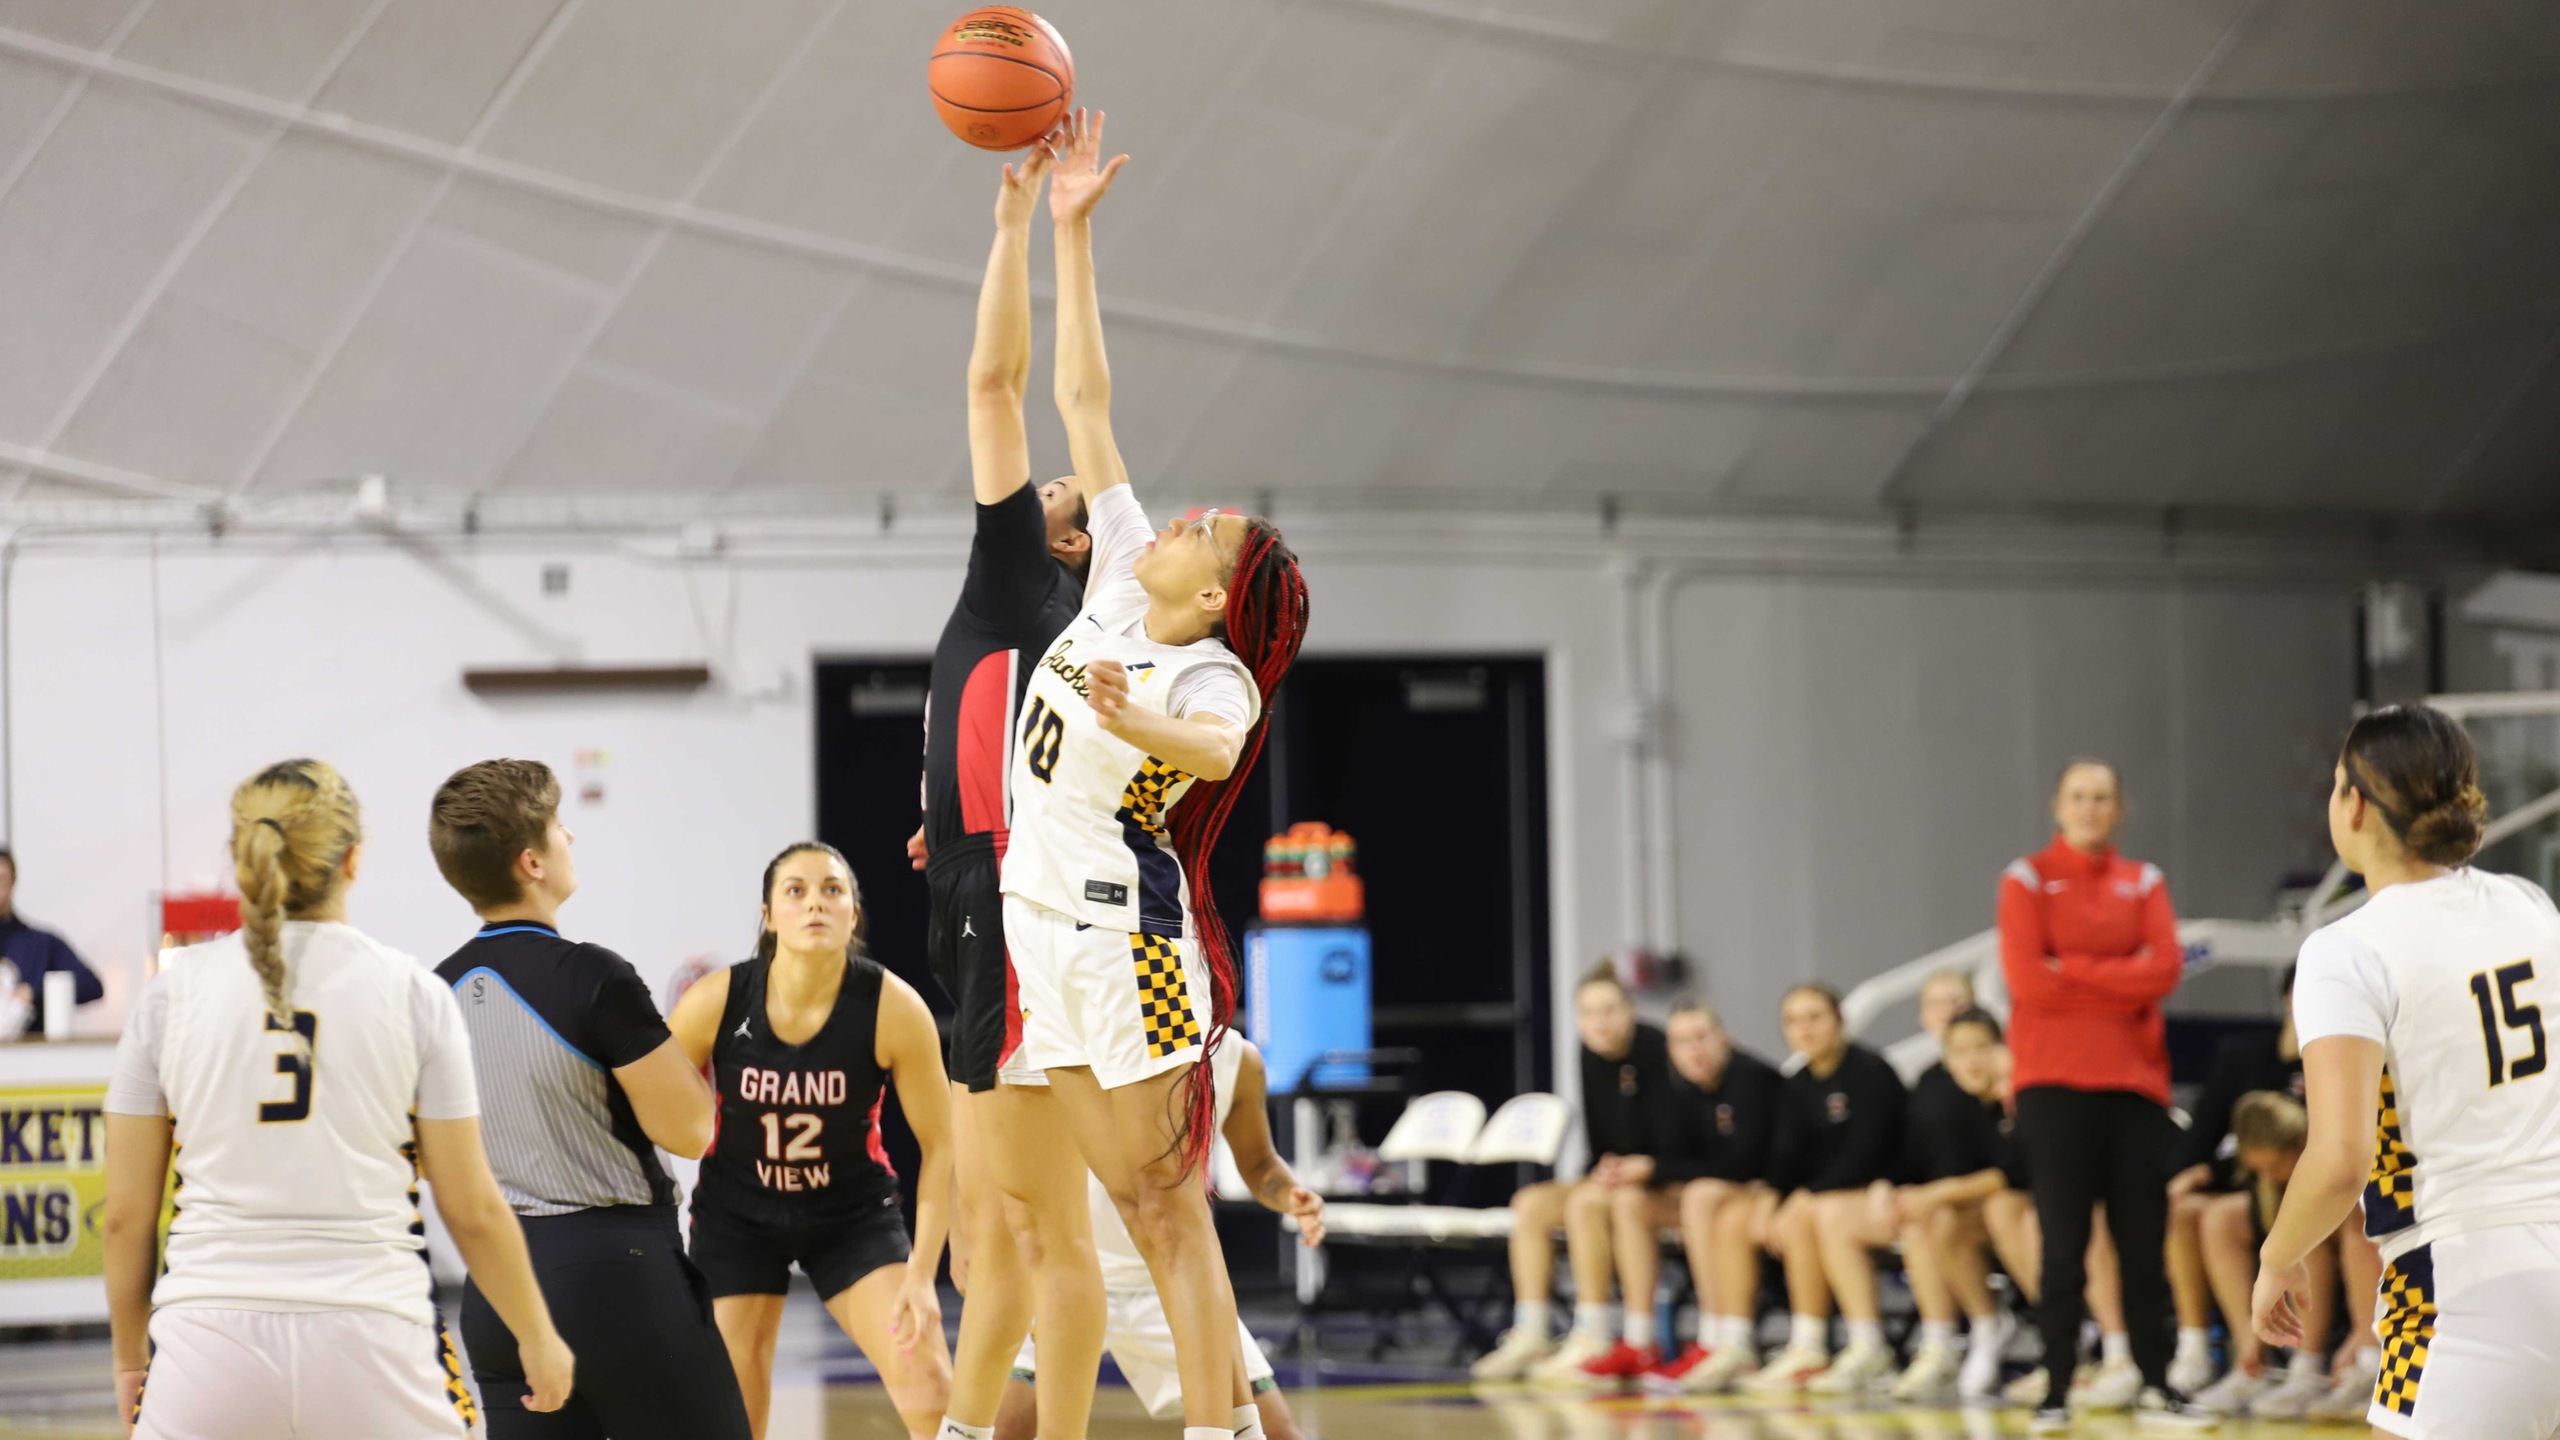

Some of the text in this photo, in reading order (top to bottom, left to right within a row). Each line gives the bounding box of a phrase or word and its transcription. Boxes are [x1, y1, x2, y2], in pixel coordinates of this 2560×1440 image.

[1039, 639, 1092, 698] Jacke
[1022, 693, 1064, 785] 10
[2470, 956, 2547, 1089] 15
[257, 1008, 319, 1125] 3
[740, 1066, 847, 1106] GRAND
[759, 1111, 823, 1162] 12
[756, 1158, 831, 1192] VIEW
